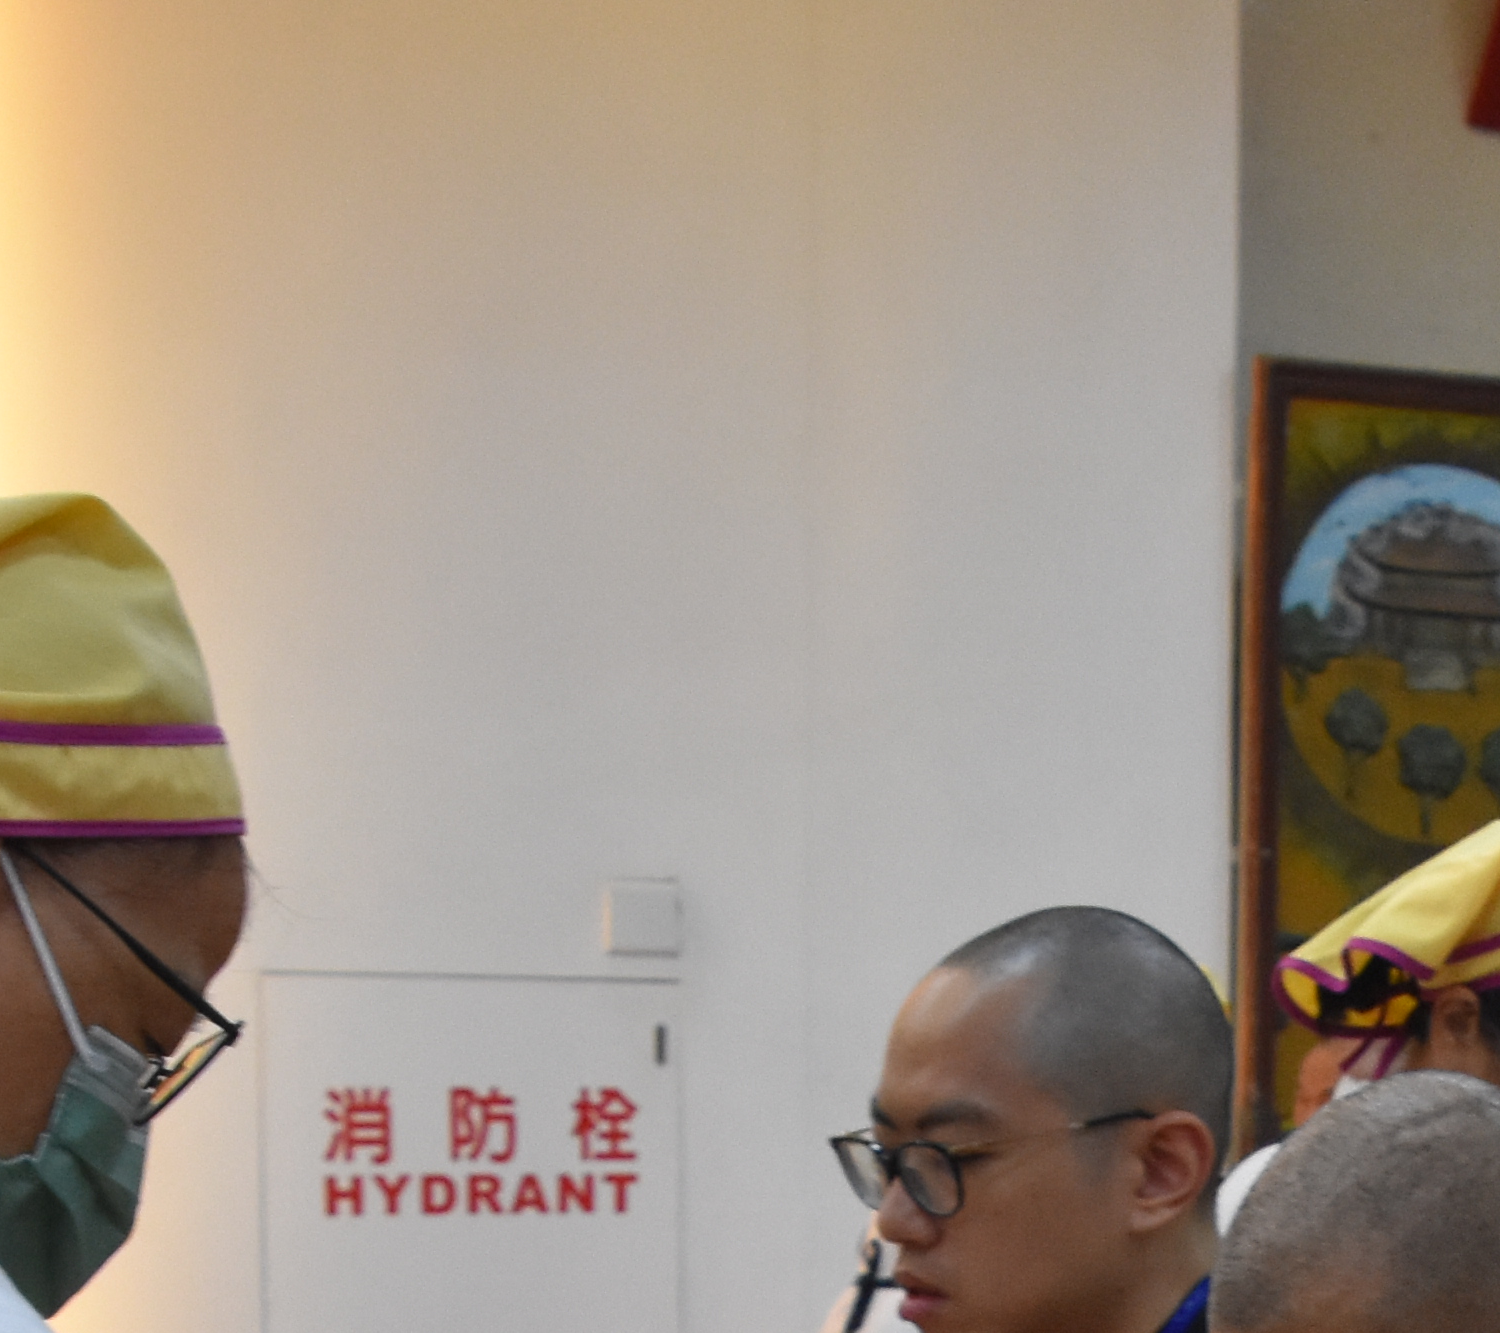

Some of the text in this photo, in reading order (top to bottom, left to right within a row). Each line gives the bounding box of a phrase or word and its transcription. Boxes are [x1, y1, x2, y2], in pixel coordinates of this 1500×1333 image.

[324, 1087, 638, 1164] 消防栓
[324, 1174, 638, 1215] HYDRANT
